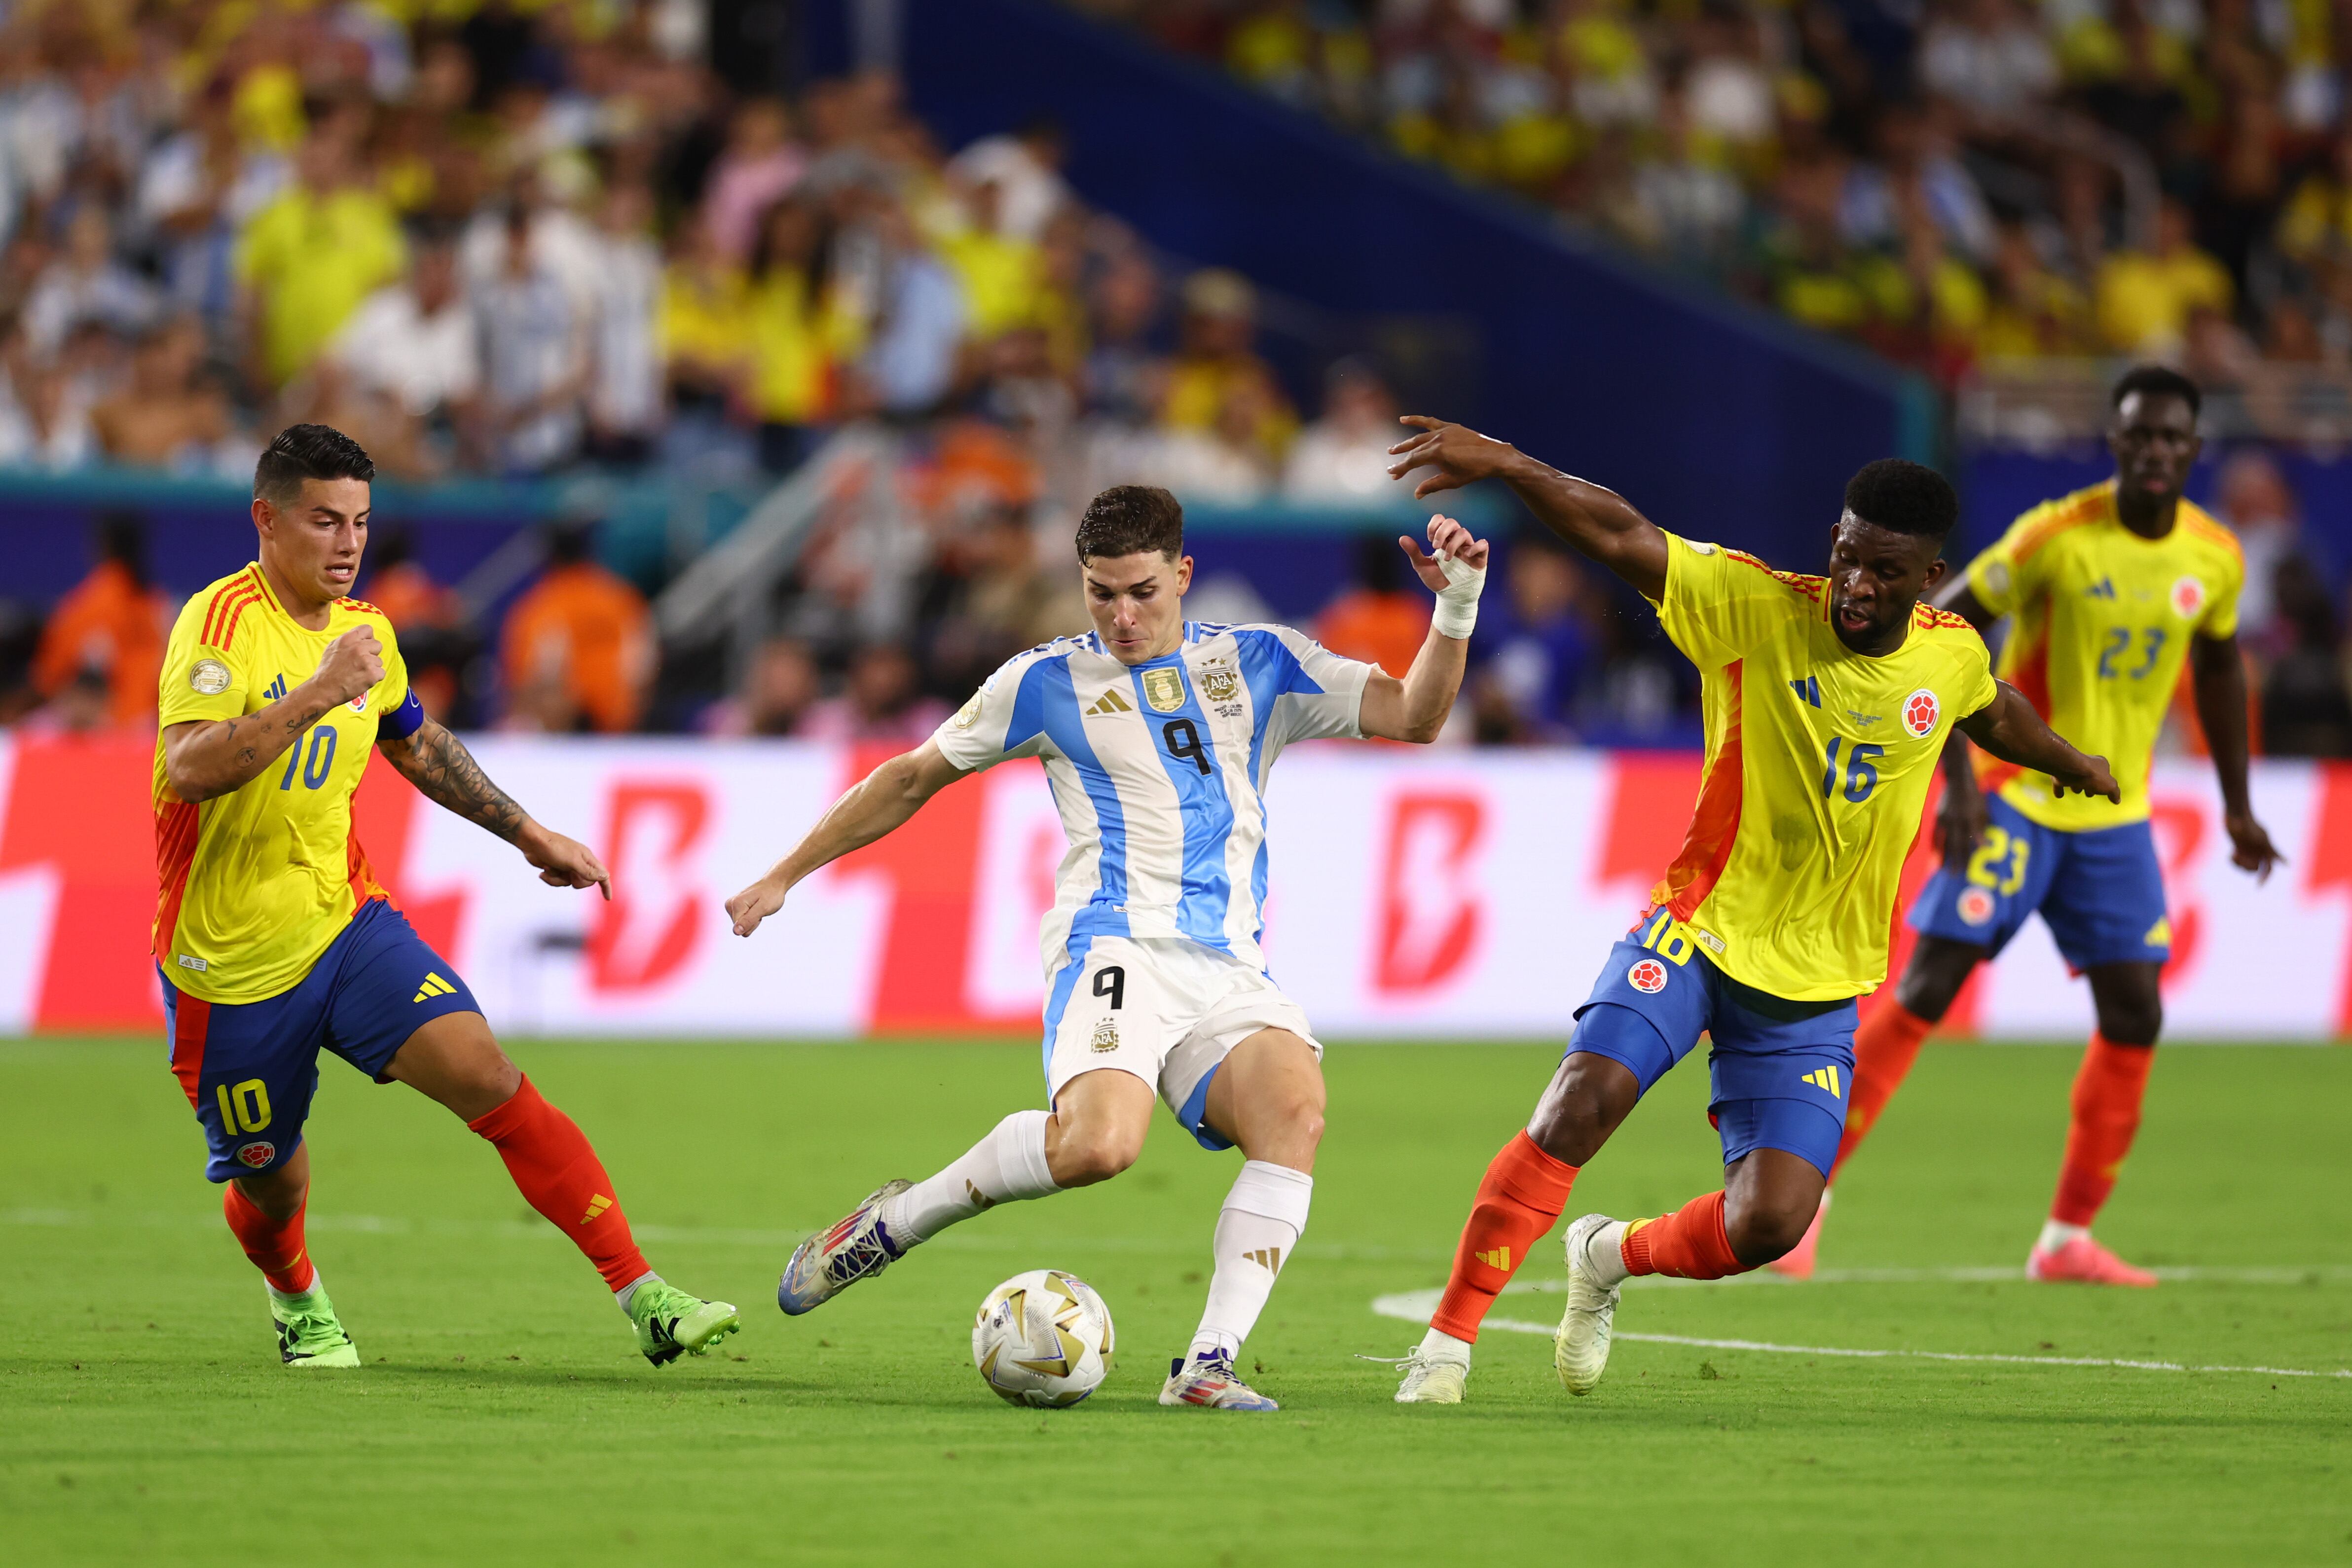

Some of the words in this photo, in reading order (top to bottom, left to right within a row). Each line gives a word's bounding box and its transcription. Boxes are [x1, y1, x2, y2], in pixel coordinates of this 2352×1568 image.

[2098, 626, 2166, 680] 23
[1210, 673, 1233, 690] AFA
[280, 726, 337, 791] 10
[1163, 719, 1212, 776] 9
[1823, 736, 1884, 802] 16
[1966, 825, 2030, 898] 23
[1642, 911, 1694, 967] 16
[1093, 966, 1125, 1010] 9
[1095, 1031, 1113, 1045] AFA
[216, 1078, 272, 1136] 10
